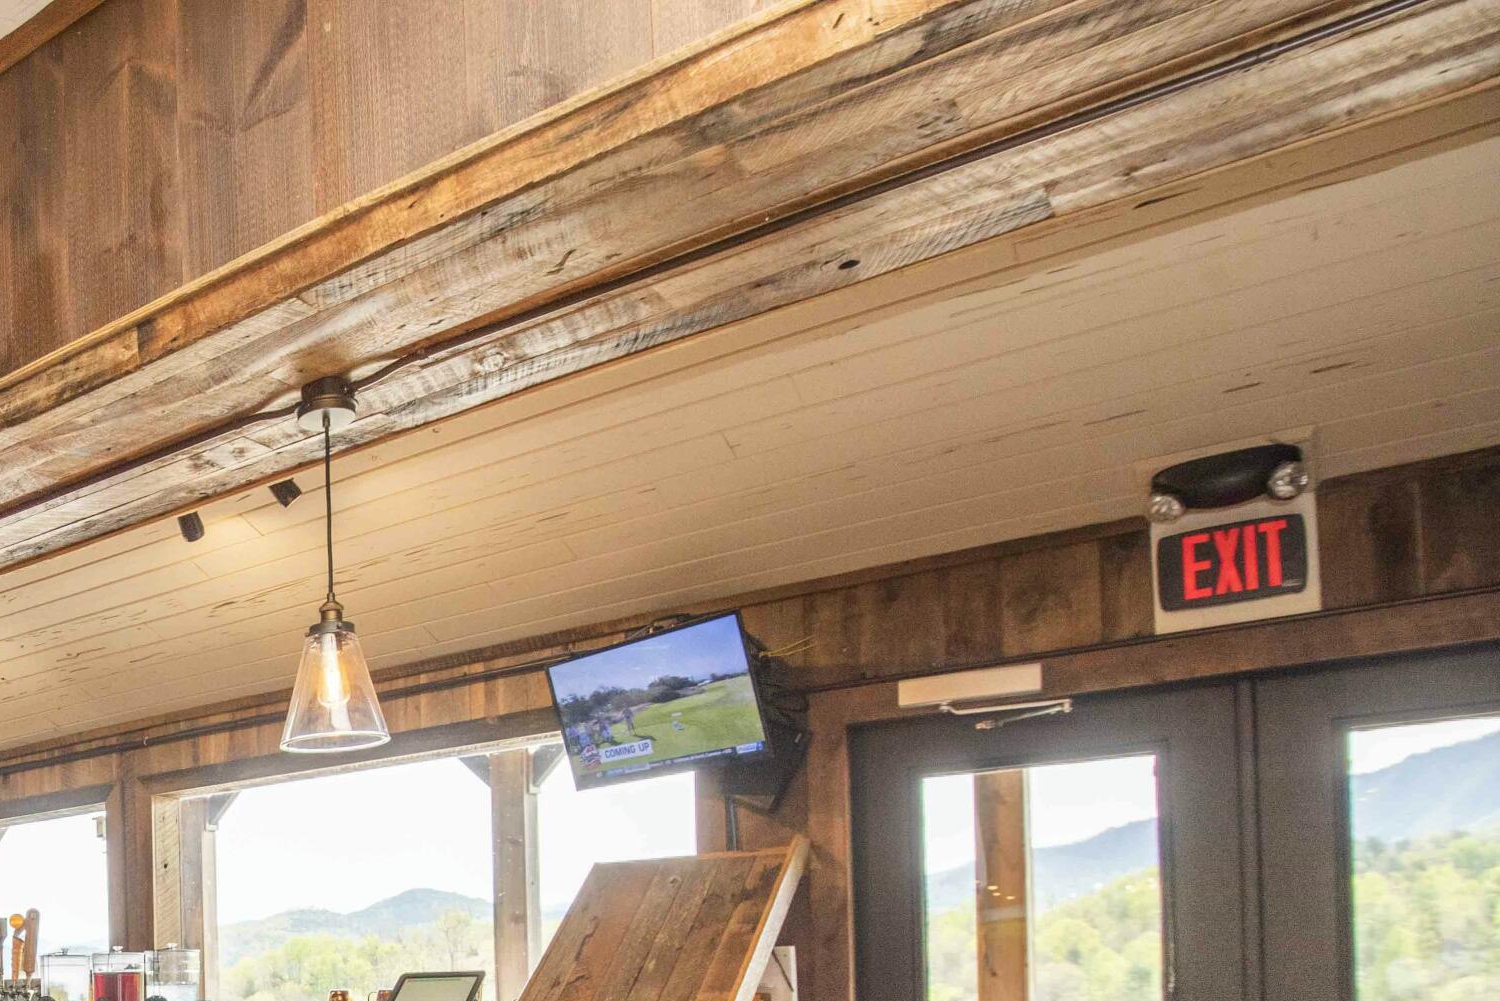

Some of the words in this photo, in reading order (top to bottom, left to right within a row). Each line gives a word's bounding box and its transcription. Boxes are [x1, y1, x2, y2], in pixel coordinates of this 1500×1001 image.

[1182, 519, 1287, 600] EXIT
[604, 745, 636, 759] COMING
[638, 742, 650, 753] UP
